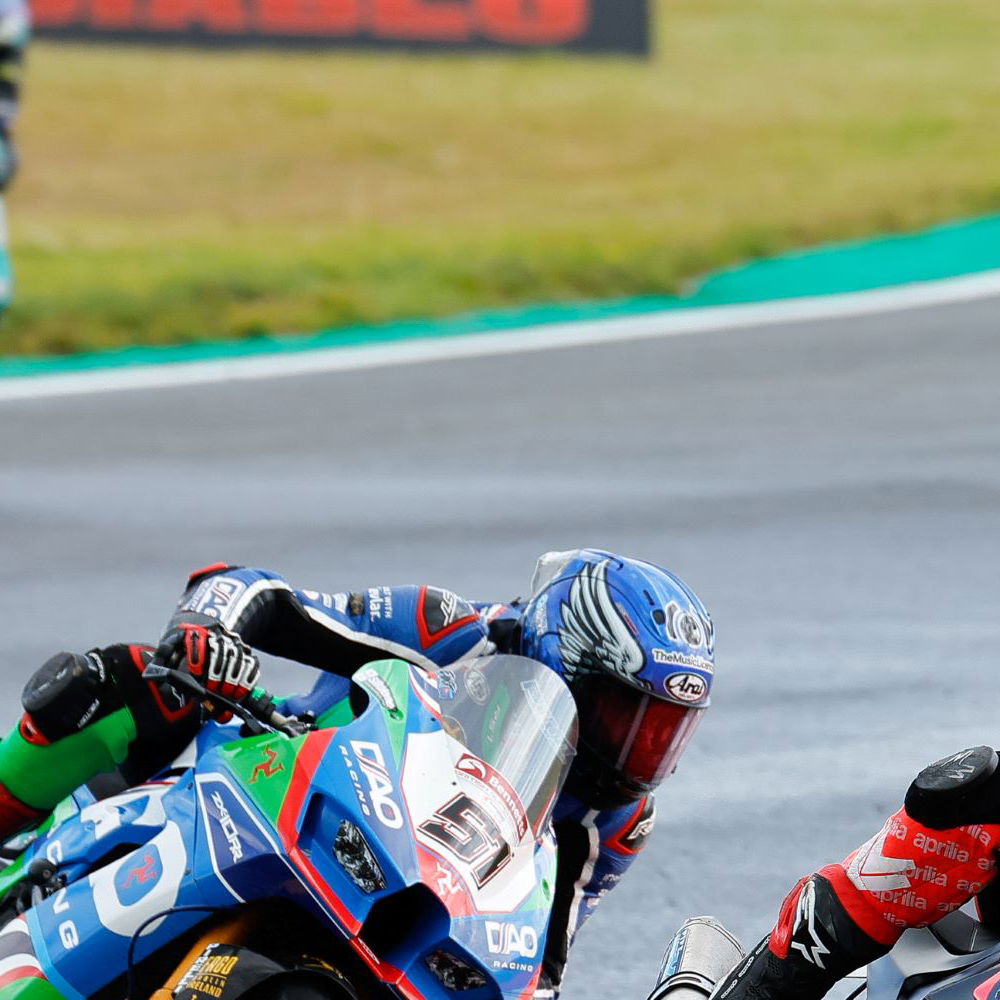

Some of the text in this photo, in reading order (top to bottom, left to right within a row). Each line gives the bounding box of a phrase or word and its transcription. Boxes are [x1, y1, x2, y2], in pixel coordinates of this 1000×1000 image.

[339, 744, 371, 817] RACING
[350, 740, 404, 829] DAO
[489, 775, 527, 837] Bennetts
[417, 791, 515, 891] 51
[913, 832, 970, 863] aprilia
[484, 920, 539, 959] DAO
[493, 961, 534, 973] RACING
